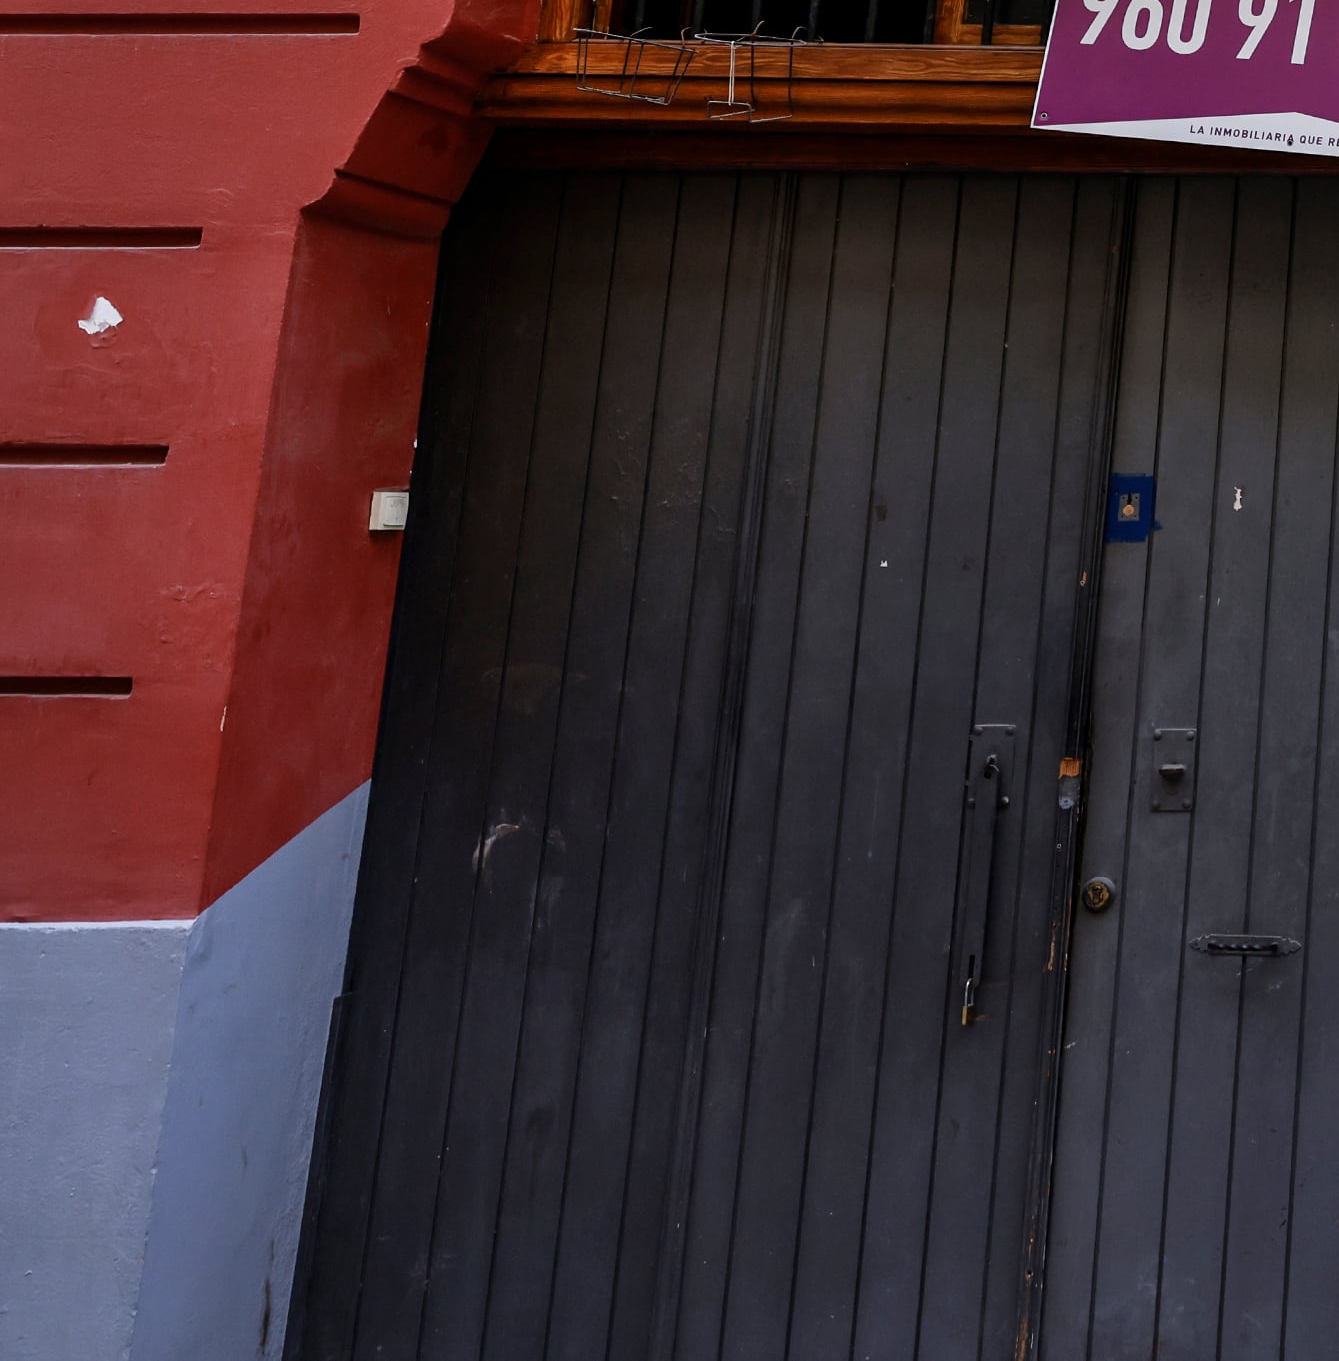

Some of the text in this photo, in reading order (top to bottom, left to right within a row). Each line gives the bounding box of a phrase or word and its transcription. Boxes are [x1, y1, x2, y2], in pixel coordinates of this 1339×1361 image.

[1189, 124, 1205, 135] LA
[1210, 126, 1295, 143] INMOBILIARIA
[1299, 135, 1323, 146] QUE
